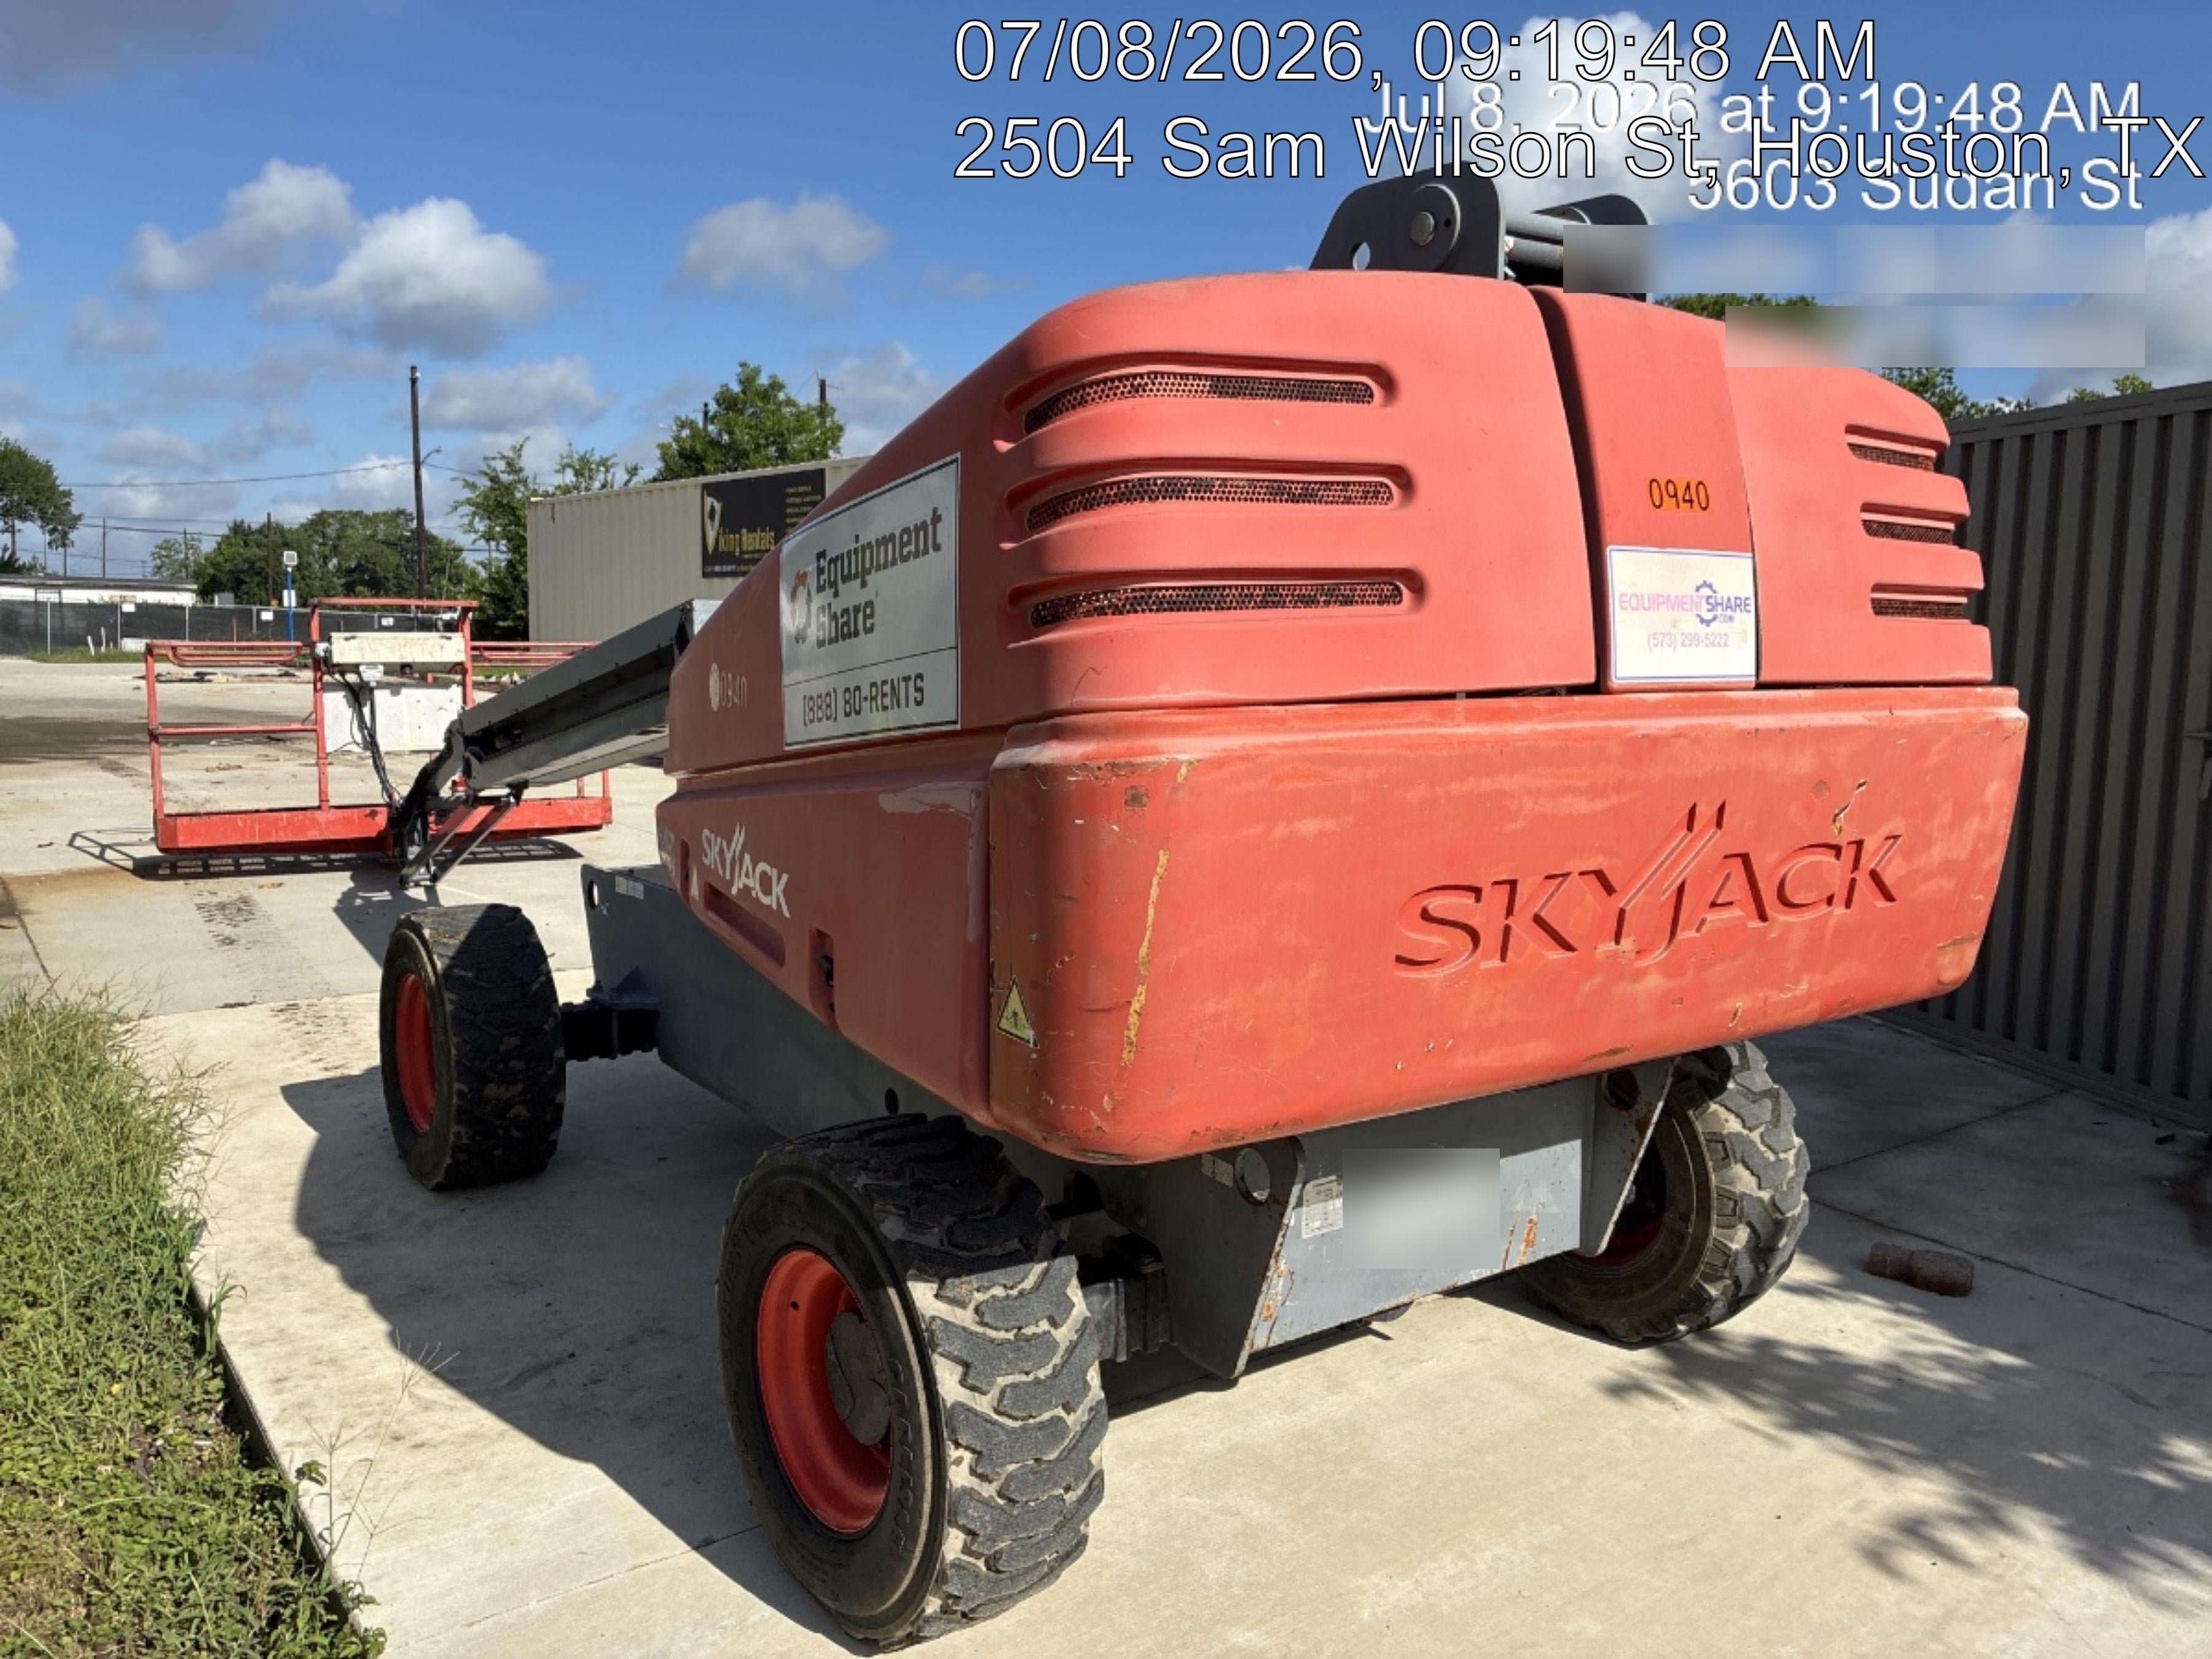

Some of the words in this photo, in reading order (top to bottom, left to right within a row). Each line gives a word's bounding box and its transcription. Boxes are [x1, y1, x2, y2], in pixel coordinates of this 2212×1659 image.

[1649, 478, 1710, 511] 0940
[815, 506, 943, 598] Equipment
[816, 598, 876, 649] Share
[1647, 632, 1677, 653] (573)
[1681, 633, 1730, 648] 299-5222
[802, 686, 838, 727] (888)
[843, 673, 925, 718] 80-RENTS
[701, 822, 791, 919] SKYJACK
[1394, 800, 1903, 978] SKYJACK
